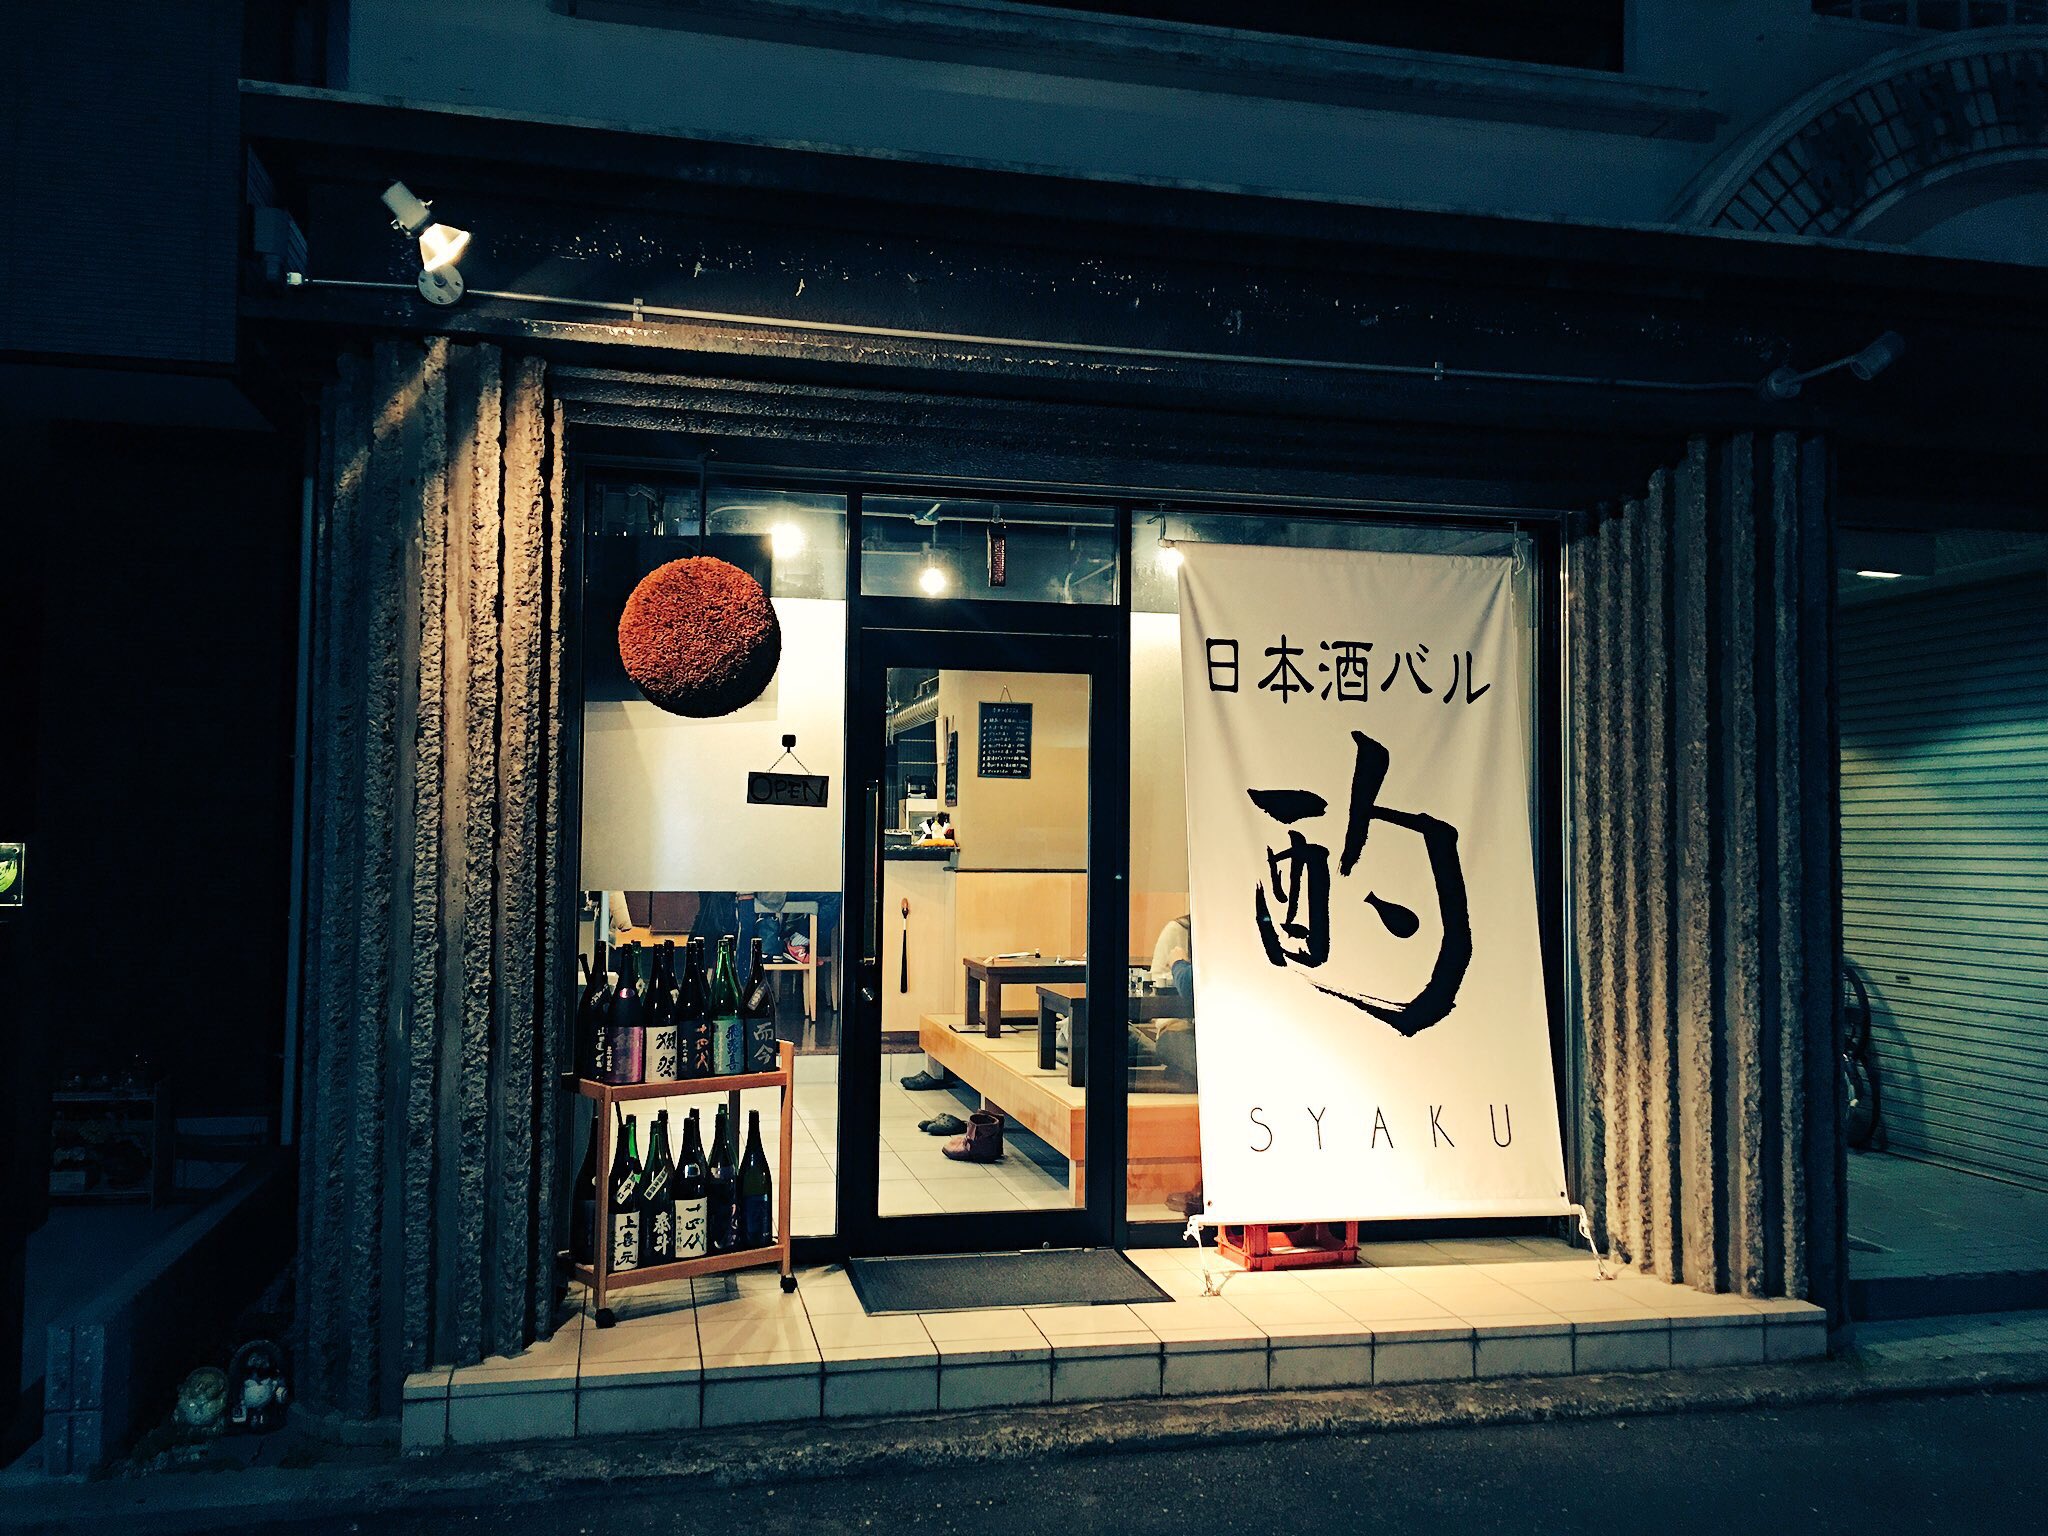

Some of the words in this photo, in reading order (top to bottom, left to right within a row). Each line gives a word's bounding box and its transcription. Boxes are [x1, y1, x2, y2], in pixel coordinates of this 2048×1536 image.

[1205, 634, 1491, 704] 日本酒バル
[751, 776, 827, 802] OPEN
[1246, 730, 1473, 1037] 酌
[726, 1024, 741, 1071] 飛露喜
[753, 1021, 775, 1065] 而今
[1249, 1104, 1513, 1152] SYAKU
[615, 1216, 638, 1266] 上喜元
